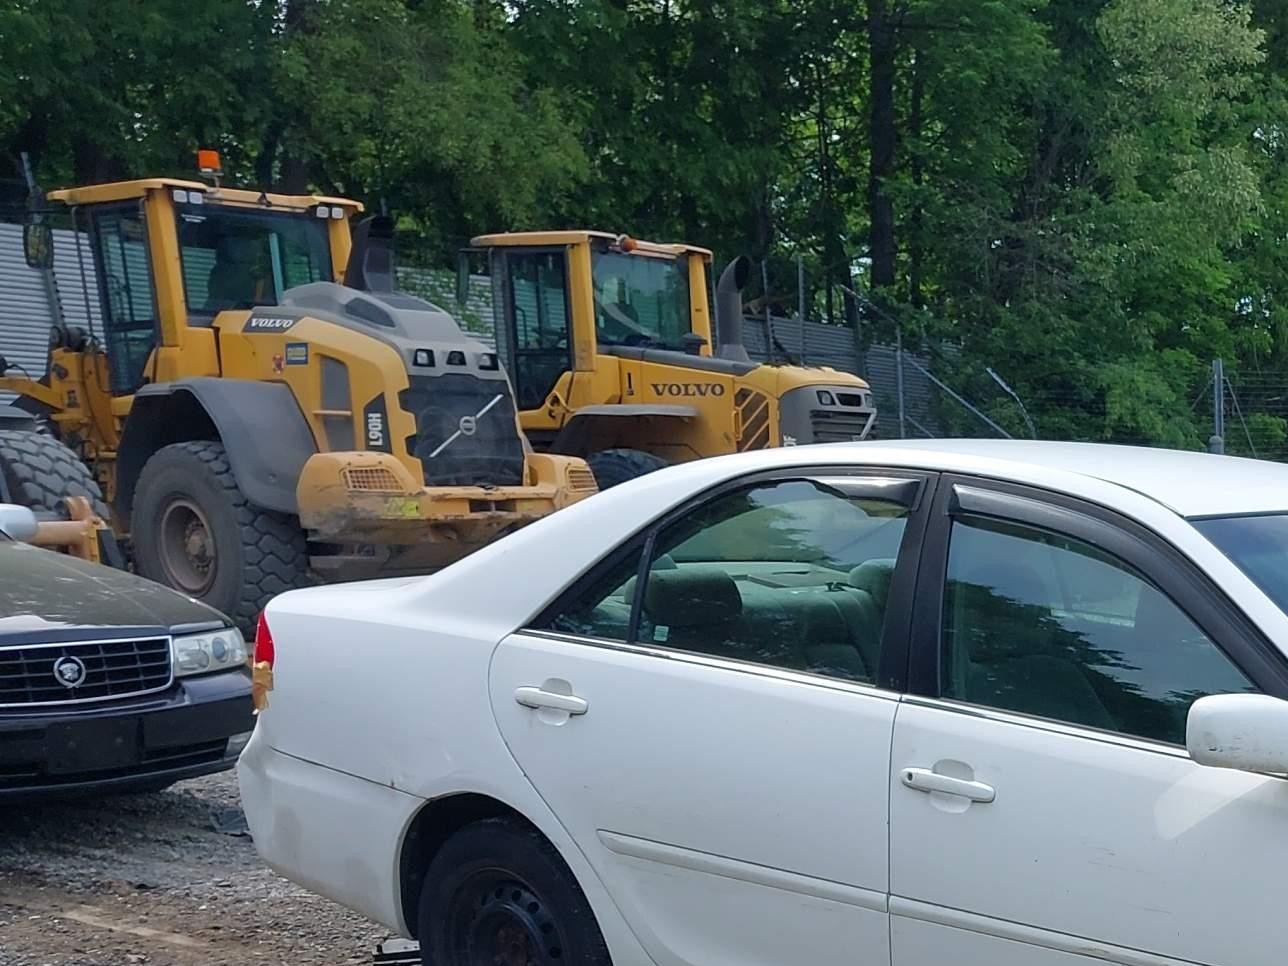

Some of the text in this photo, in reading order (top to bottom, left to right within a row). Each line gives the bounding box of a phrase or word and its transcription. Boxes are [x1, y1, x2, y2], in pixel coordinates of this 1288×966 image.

[251, 317, 294, 328] VOLVO
[651, 383, 725, 396] VOLVO
[367, 412, 383, 446] L90H
